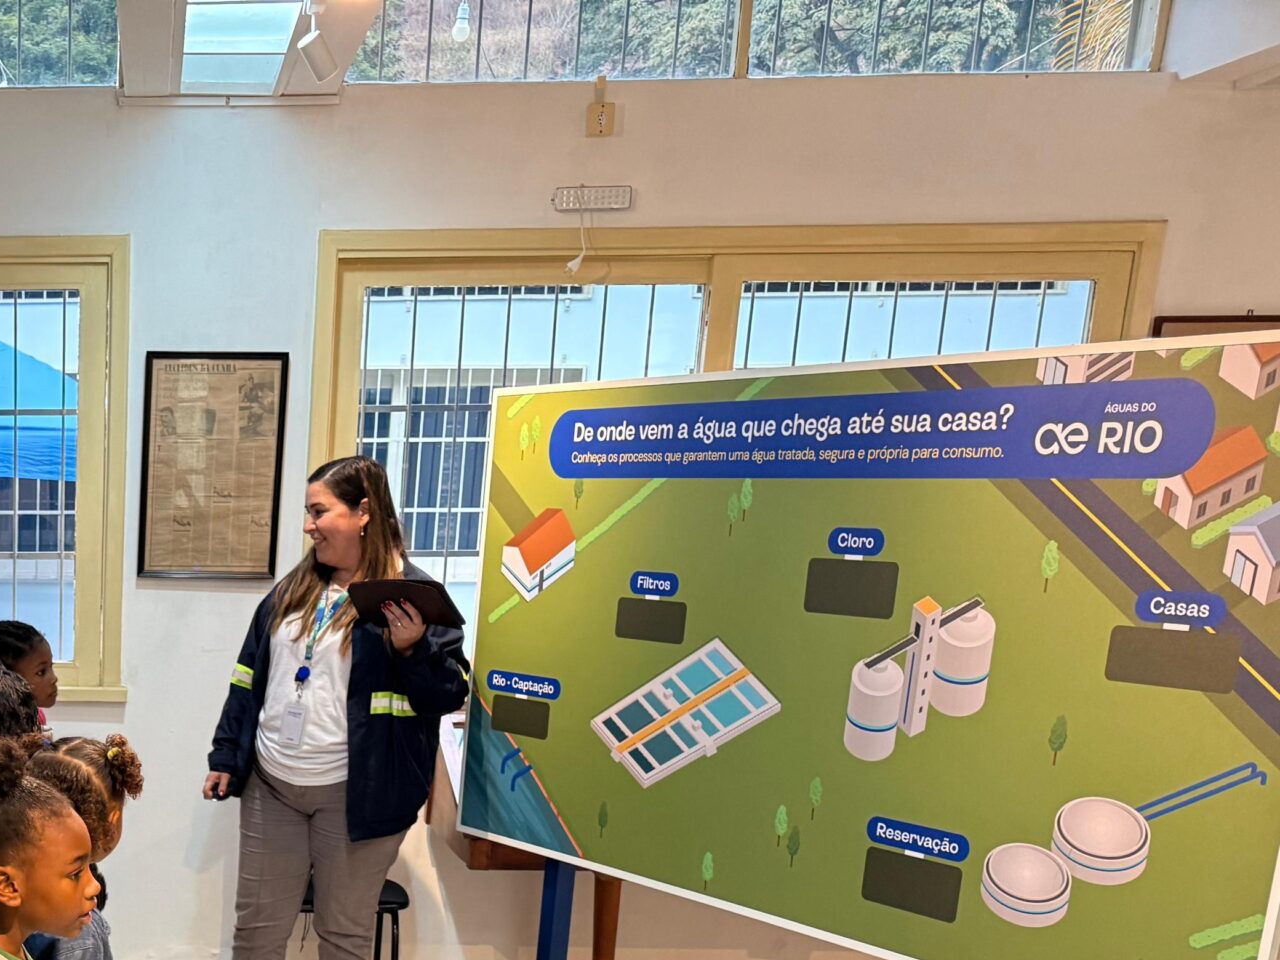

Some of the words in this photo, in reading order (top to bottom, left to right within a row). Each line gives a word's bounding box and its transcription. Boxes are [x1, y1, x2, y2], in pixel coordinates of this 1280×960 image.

[1104, 402, 1139, 413] ÁGUAS
[1140, 402, 1157, 412] DO
[573, 422, 594, 443] De
[596, 420, 635, 442] onde
[639, 422, 673, 441] vem
[677, 423, 689, 439] a
[693, 416, 737, 444] água
[741, 420, 776, 443] que
[781, 413, 841, 442] chega
[847, 408, 884, 434] até
[890, 413, 931, 433] sua
[937, 403, 1015, 432] casa?
[1097, 420, 1163, 454] RIO
[571, 451, 606, 466] Conheça
[608, 453, 618, 463] os
[619, 451, 663, 465] processos
[664, 451, 681, 464] que
[682, 449, 726, 464] garantem
[728, 450, 749, 461] uma
[751, 448, 775, 464] água
[778, 446, 816, 461] tratada,
[819, 449, 855, 464] segura
[857, 449, 865, 459] e
[867, 445, 909, 462] própria
[911, 448, 939, 462] para
[942, 446, 1005, 459] consumo.
[837, 532, 874, 548] Cloro
[637, 575, 671, 591] Filtros
[1150, 596, 1210, 618] Casas
[492, 673, 506, 687] Rio
[511, 676, 554, 696] Captação
[876, 822, 959, 855] Reservação
